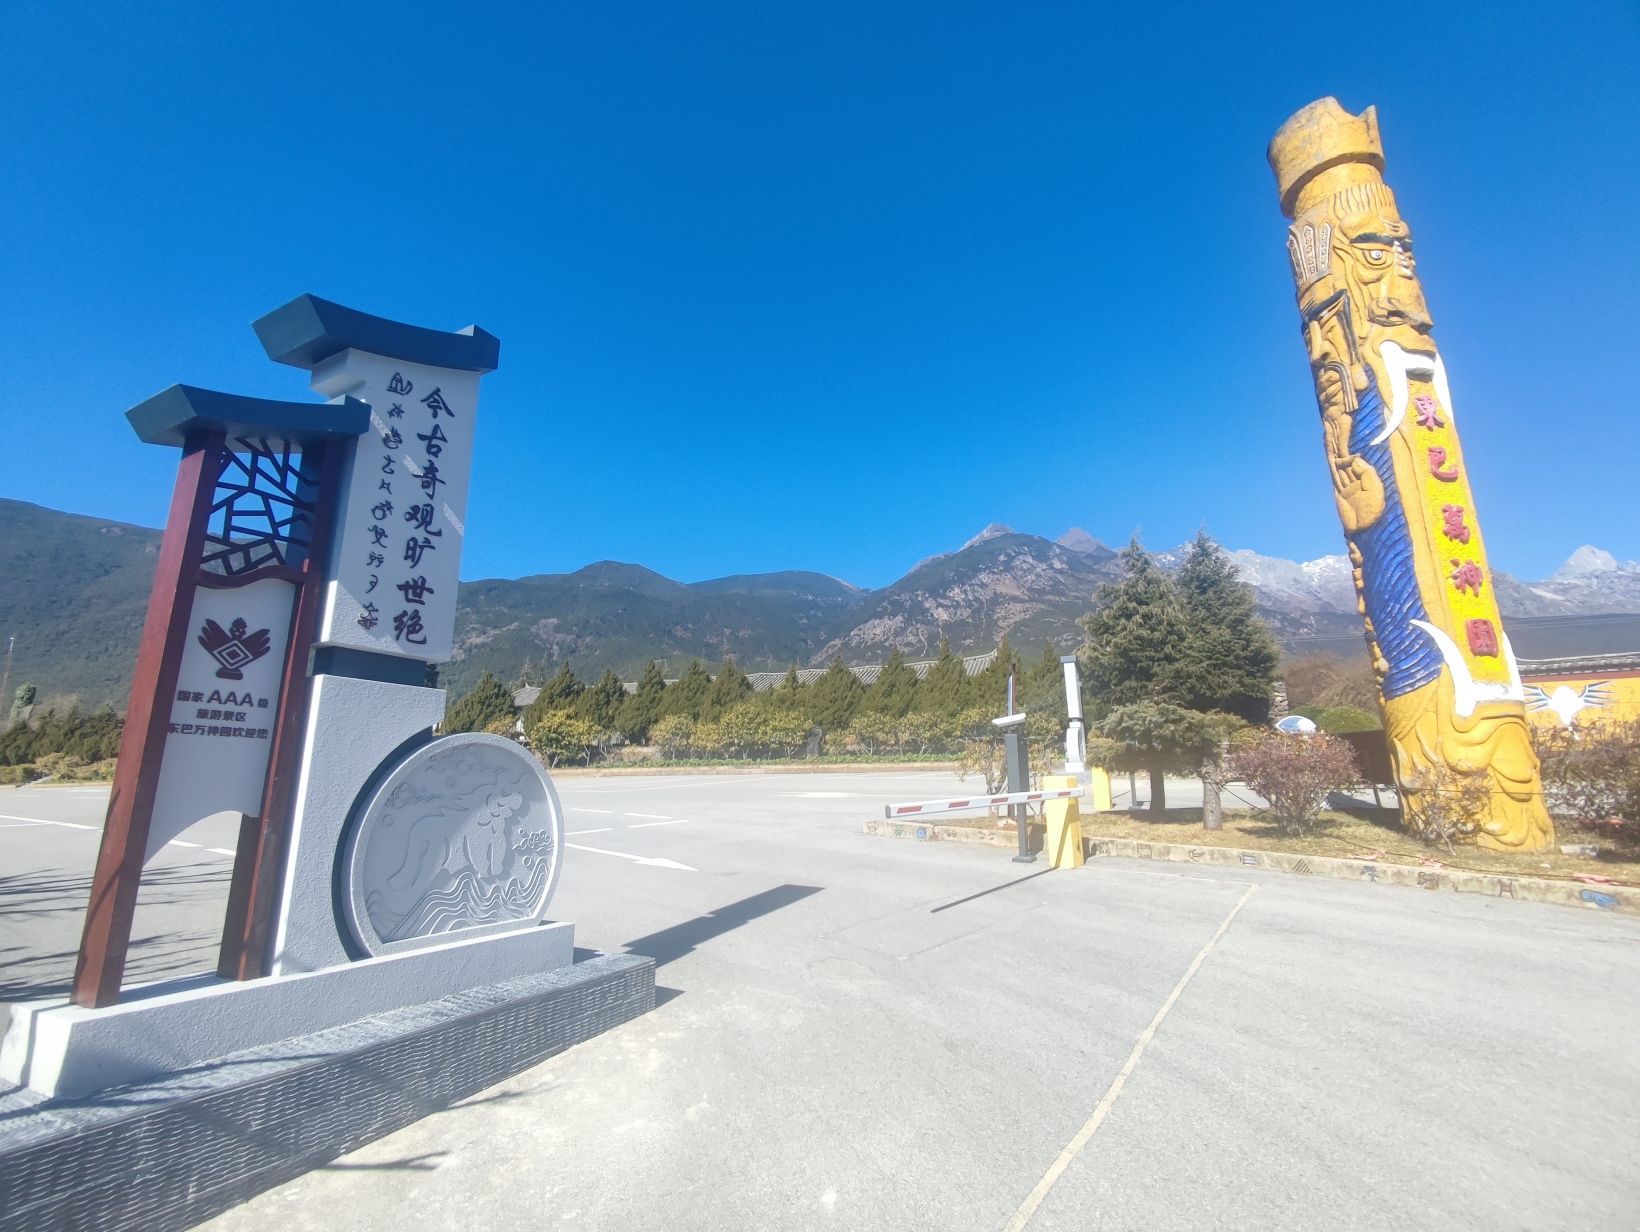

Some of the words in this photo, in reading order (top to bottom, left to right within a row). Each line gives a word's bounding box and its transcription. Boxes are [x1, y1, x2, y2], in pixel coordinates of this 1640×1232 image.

[393, 387, 455, 645] 今古奇观旷世绝
[196, 709, 248, 723] 旅游景区
[167, 723, 269, 740] 东巴万神园欢迎您
